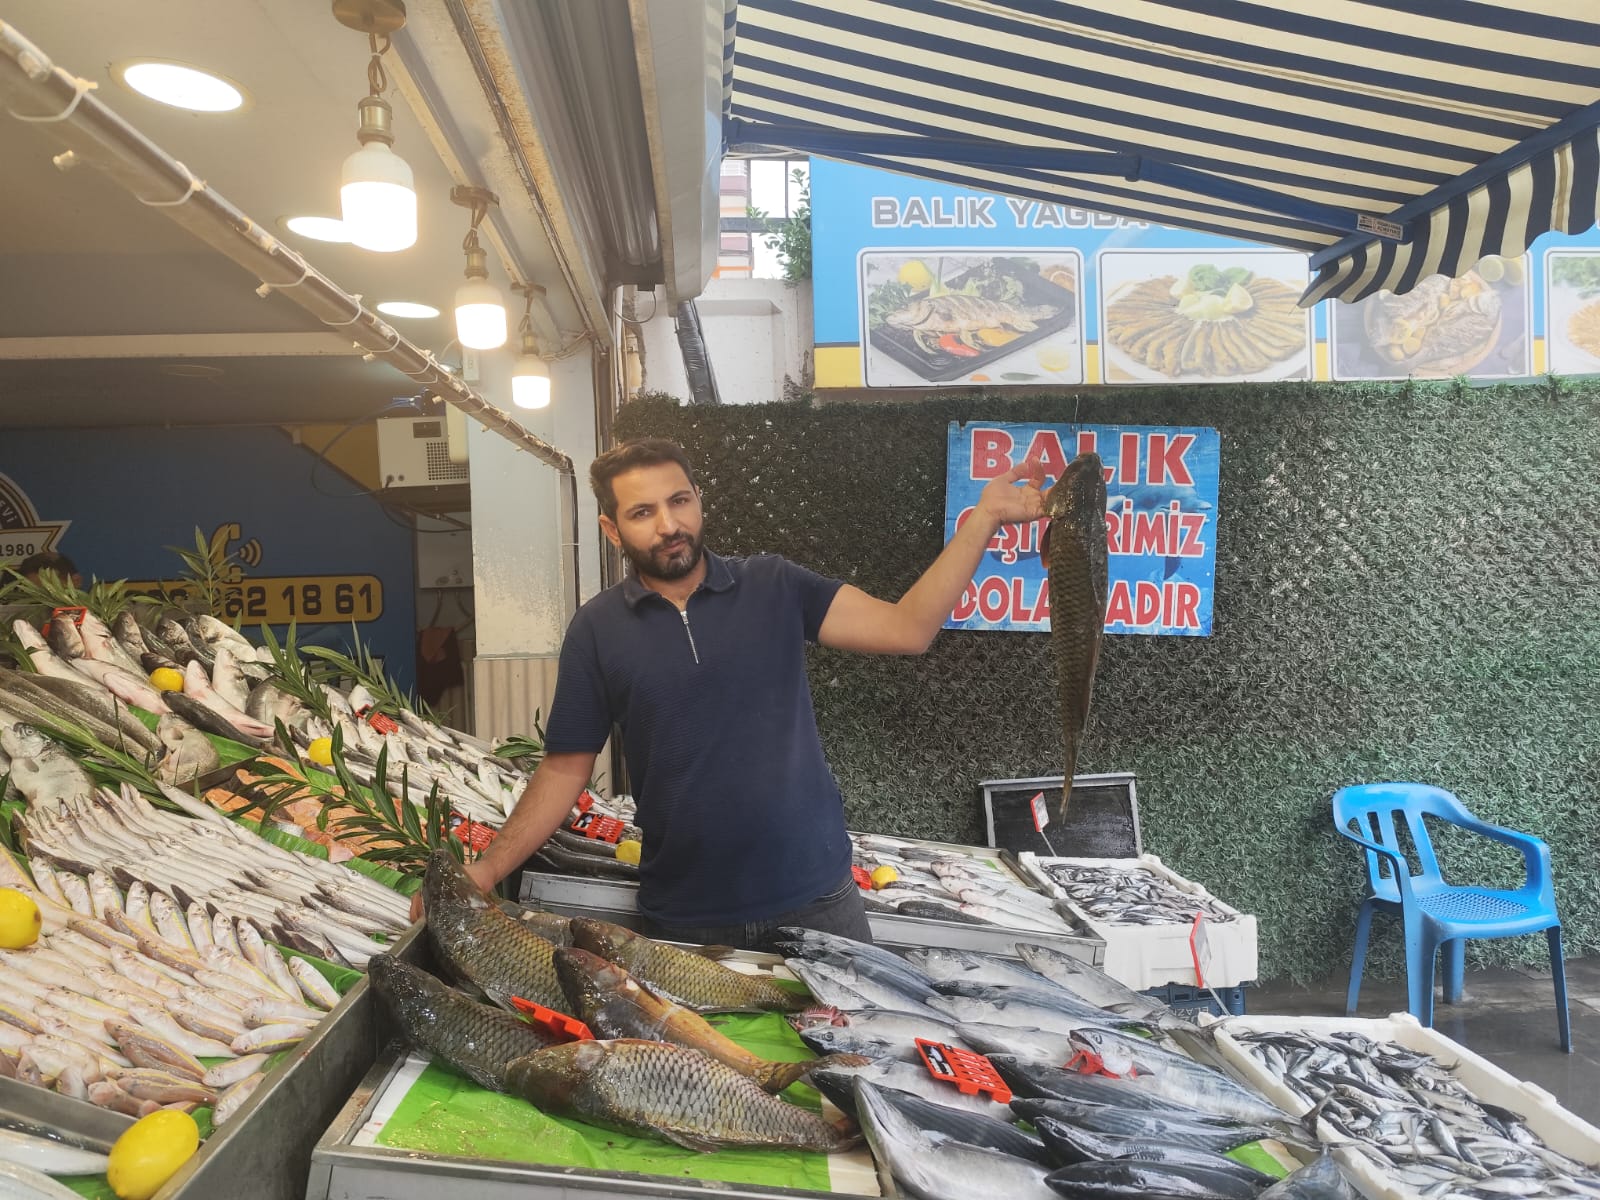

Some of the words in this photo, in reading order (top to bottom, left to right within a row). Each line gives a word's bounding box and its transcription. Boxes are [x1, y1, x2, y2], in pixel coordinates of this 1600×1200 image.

[872, 197, 996, 228] BALIK
[281, 584, 322, 616] 18
[334, 582, 374, 615] 61
